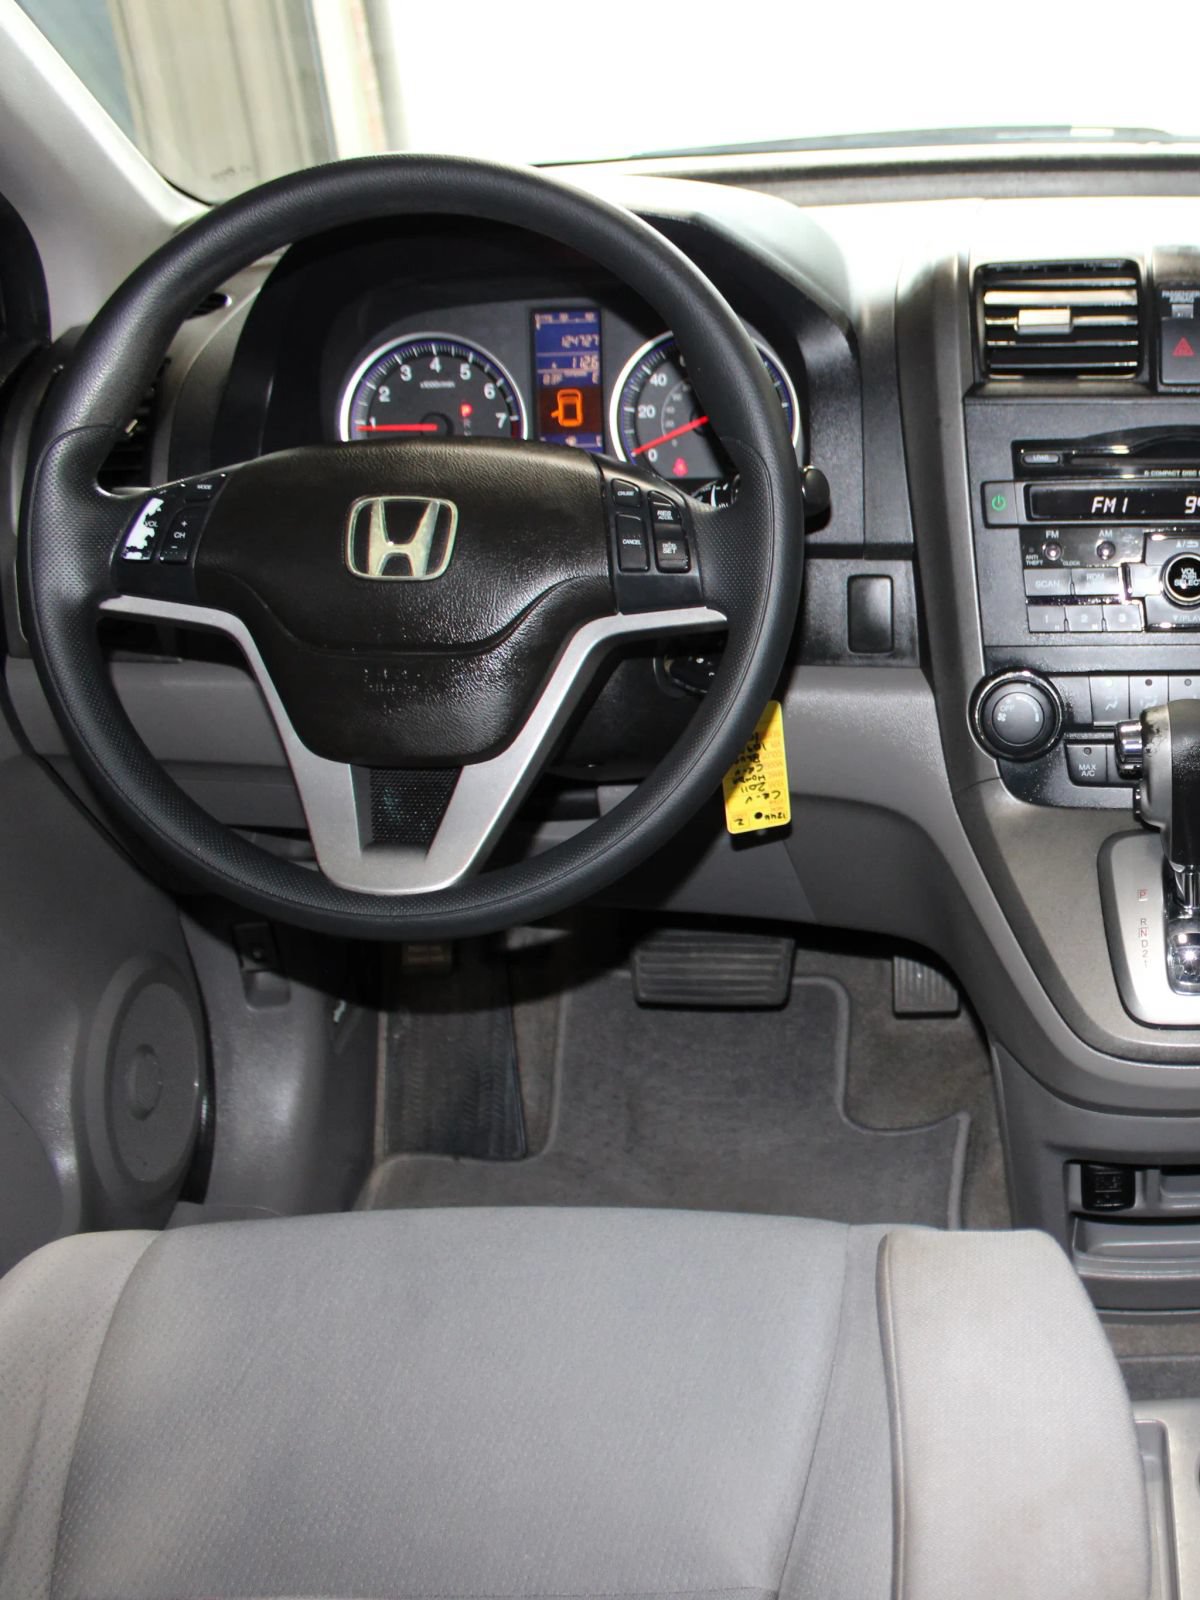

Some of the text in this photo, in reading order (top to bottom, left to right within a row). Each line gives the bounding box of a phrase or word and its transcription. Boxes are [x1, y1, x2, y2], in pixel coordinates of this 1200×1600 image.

[430, 356, 442, 373] 4
[400, 364, 412, 381] 3
[460, 363, 472, 380] 5
[650, 374, 668, 387] 40
[378, 385, 391, 402] 2
[483, 382, 496, 400] 6
[638, 404, 656, 418] 20
[495, 412, 507, 429] 7
[648, 448, 658, 462] 0
[1045, 529, 1060, 539] FM
[1098, 529, 1113, 538] AM
[1034, 580, 1061, 588] SCAN
[1140, 918, 1147, 926] R
[1140, 928, 1147, 937] N
[1142, 939, 1149, 948] D
[1142, 949, 1149, 958] 2
